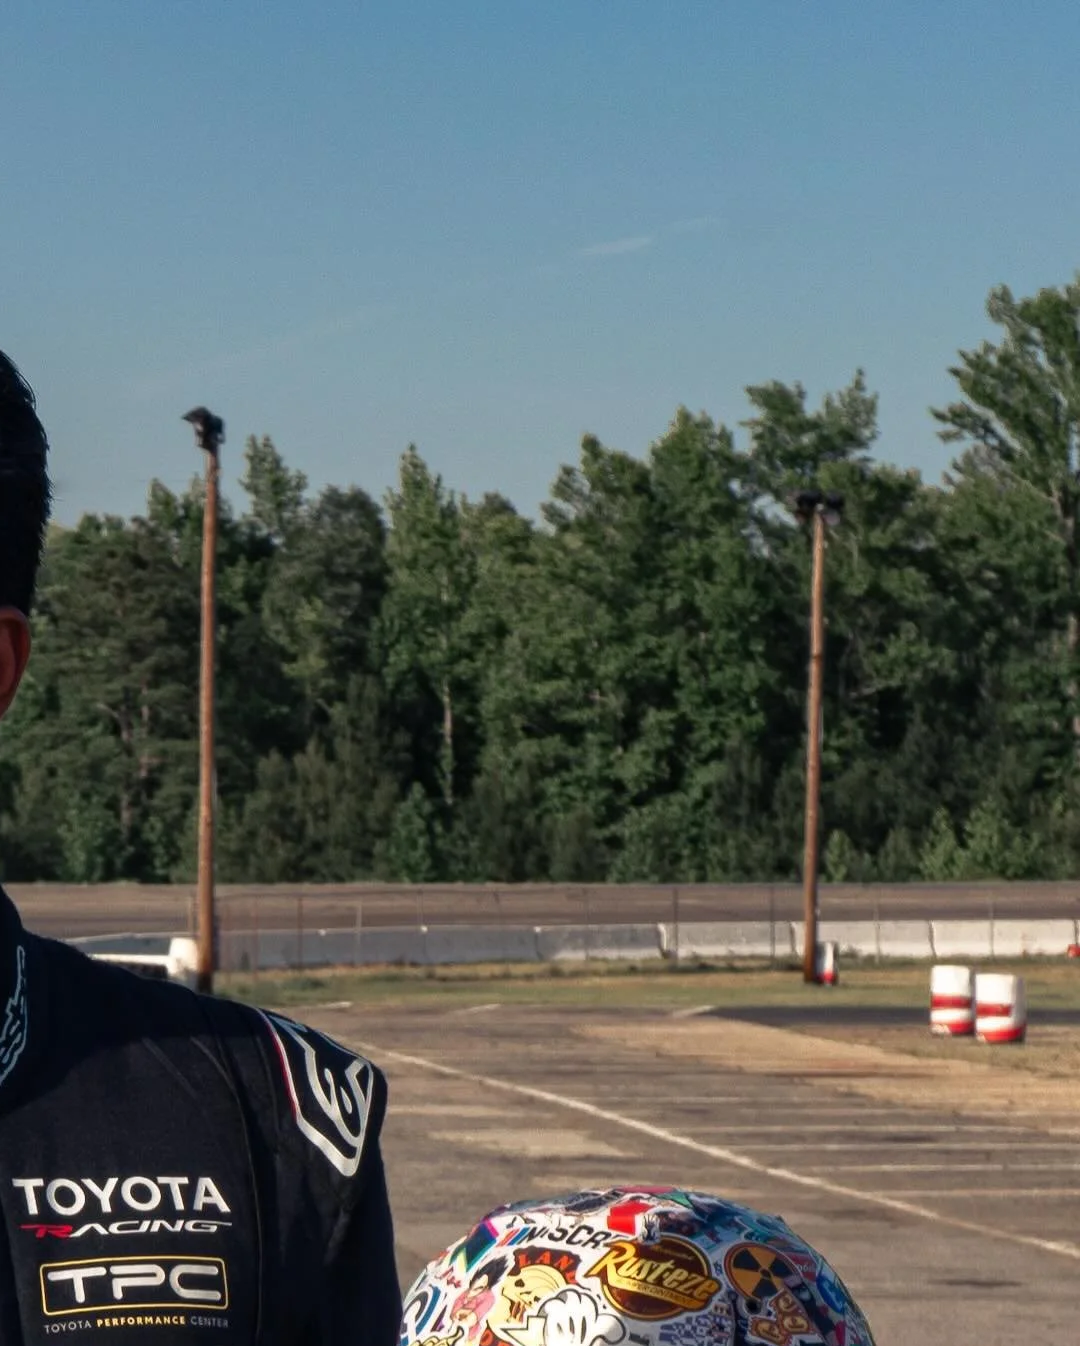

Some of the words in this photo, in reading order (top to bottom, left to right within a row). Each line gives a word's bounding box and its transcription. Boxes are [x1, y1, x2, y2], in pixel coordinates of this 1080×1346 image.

[12, 1176, 232, 1217] TOYOTA
[20, 1219, 233, 1239] RACING
[47, 1264, 223, 1304] TPC
[44, 1320, 92, 1335] TOYOTA
[96, 1316, 186, 1328] PERFORMANCE
[190, 1315, 229, 1329] CENTER
